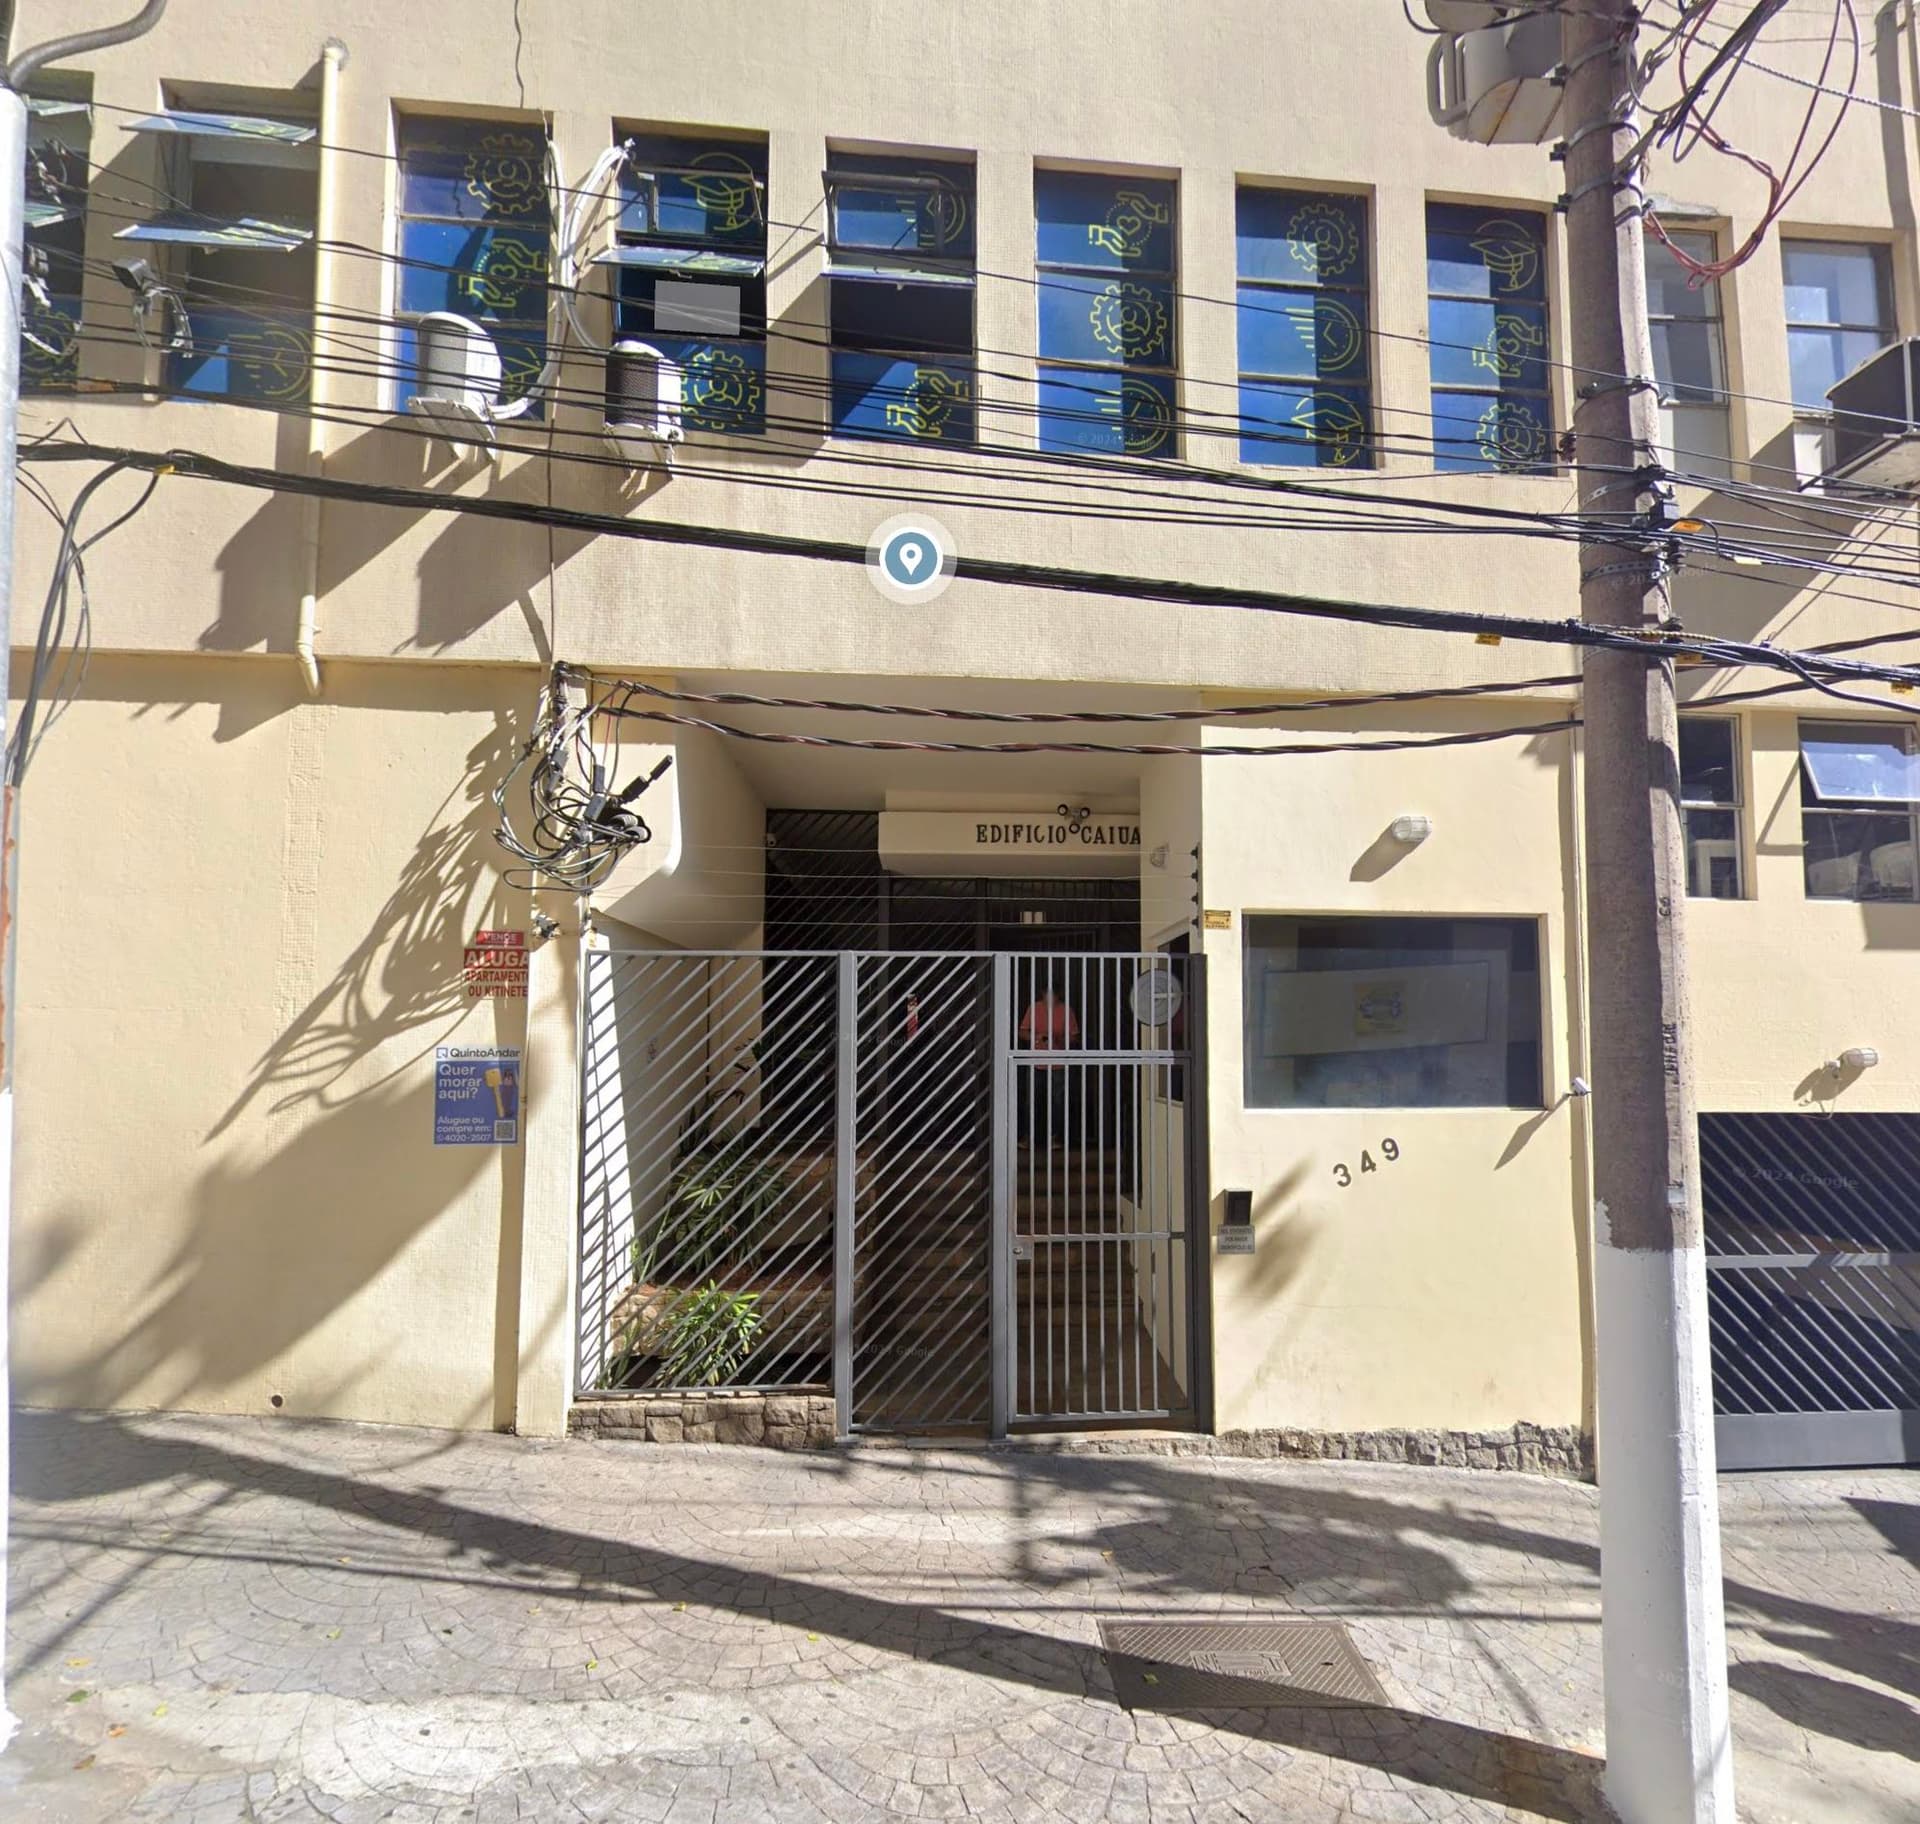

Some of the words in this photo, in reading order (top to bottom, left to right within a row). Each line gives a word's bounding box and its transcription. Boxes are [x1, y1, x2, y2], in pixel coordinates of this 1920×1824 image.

[976, 824, 1066, 844] EDIFICIO
[468, 985, 482, 998] OU
[450, 1047, 520, 1058] QuintoAndar
[440, 1063, 476, 1076] Quer
[439, 1077, 483, 1088] morar
[439, 1087, 478, 1102] aqui?
[437, 1116, 470, 1126] Alugue
[471, 1117, 485, 1125] ou
[1333, 1137, 1400, 1188] 349
